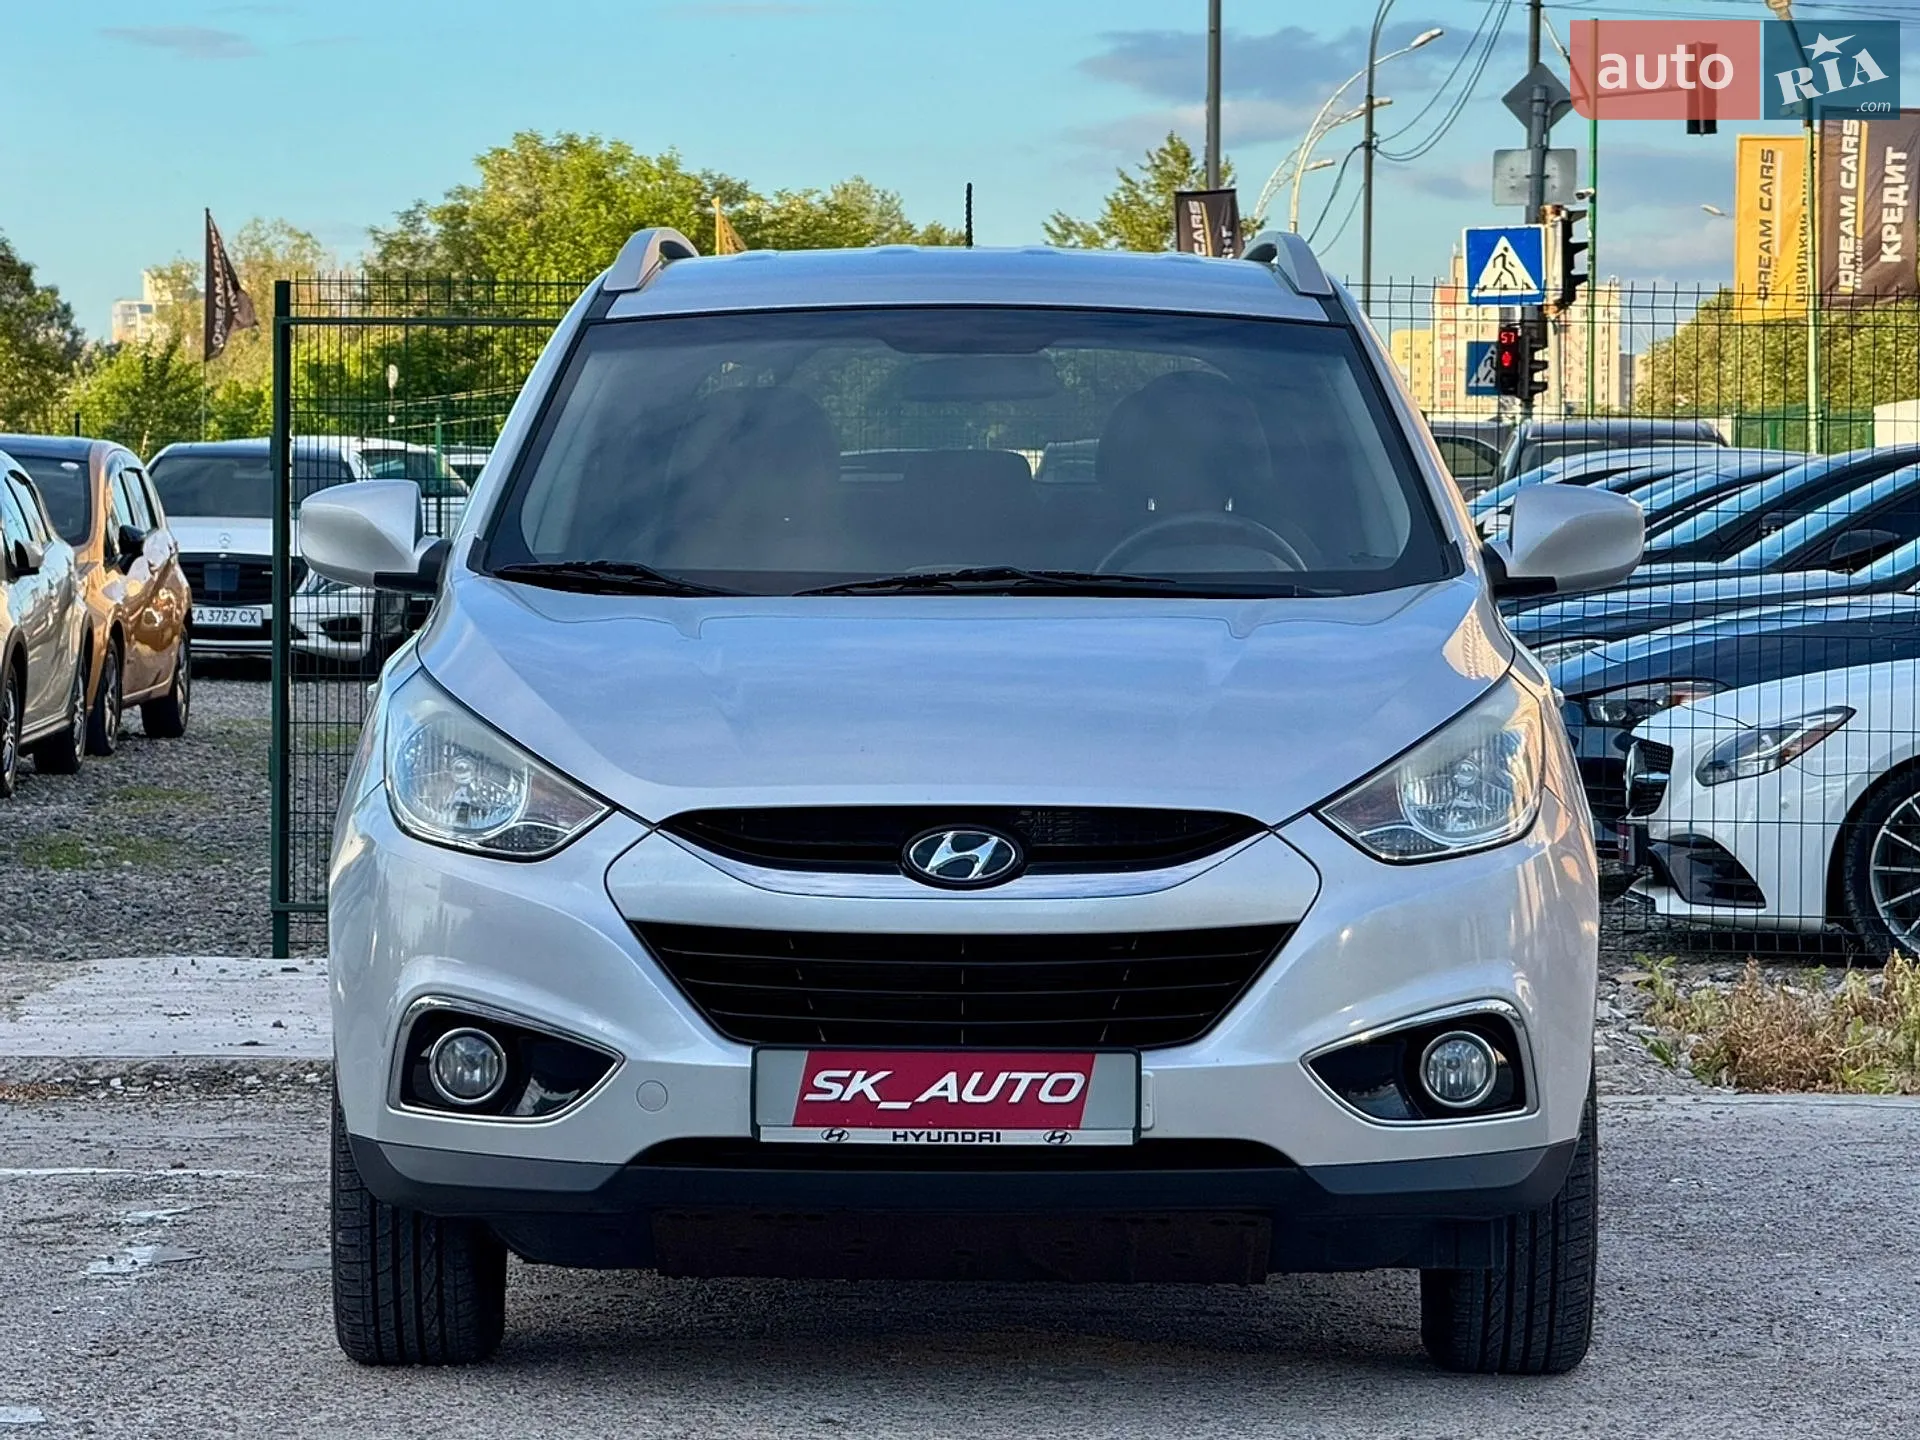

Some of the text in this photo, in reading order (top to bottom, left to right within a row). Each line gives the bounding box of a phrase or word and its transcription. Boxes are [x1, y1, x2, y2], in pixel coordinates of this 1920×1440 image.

[1757, 148, 1776, 301] DREAM CARS
[1838, 119, 1860, 286] DREAM CARS
[1879, 145, 1909, 263] КРЕДИТ
[802, 1069, 1087, 1111] SK_AUTO
[891, 1129, 1002, 1144] HYUNDAI
